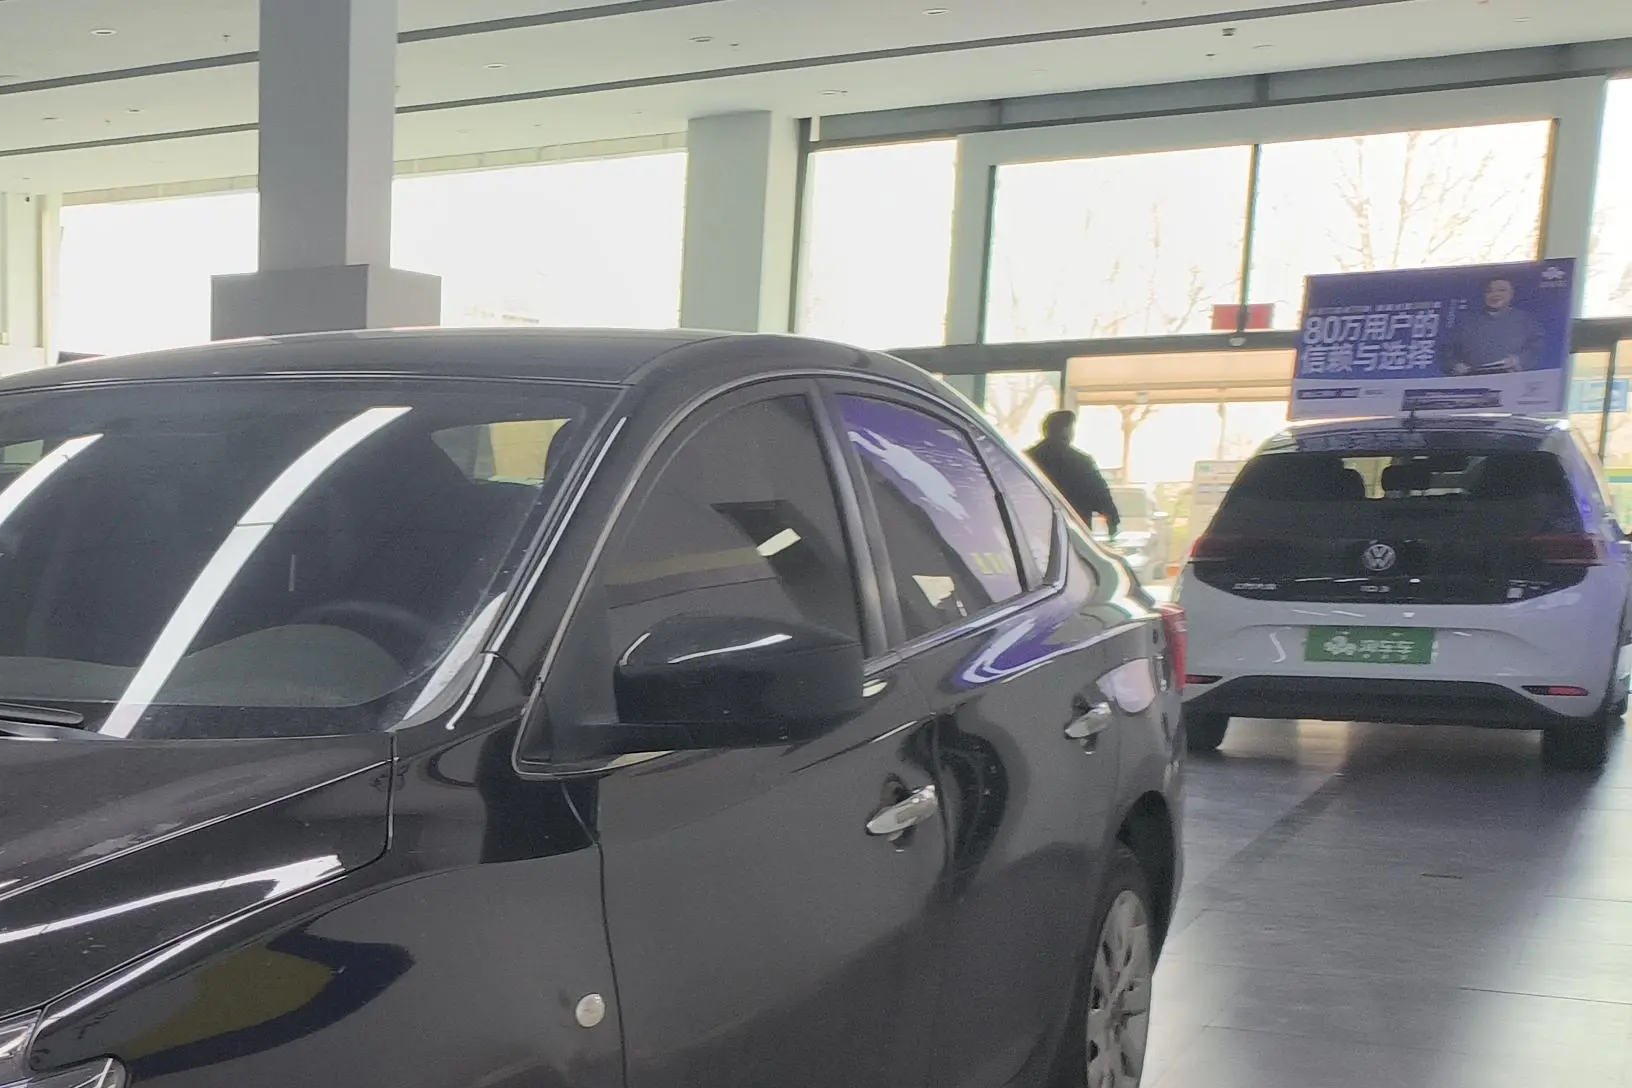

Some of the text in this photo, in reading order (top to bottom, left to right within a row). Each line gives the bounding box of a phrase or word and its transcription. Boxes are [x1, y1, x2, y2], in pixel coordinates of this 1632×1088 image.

[1302, 308, 1441, 345] 80万用户的
[1301, 339, 1437, 374] 信赖与选择
